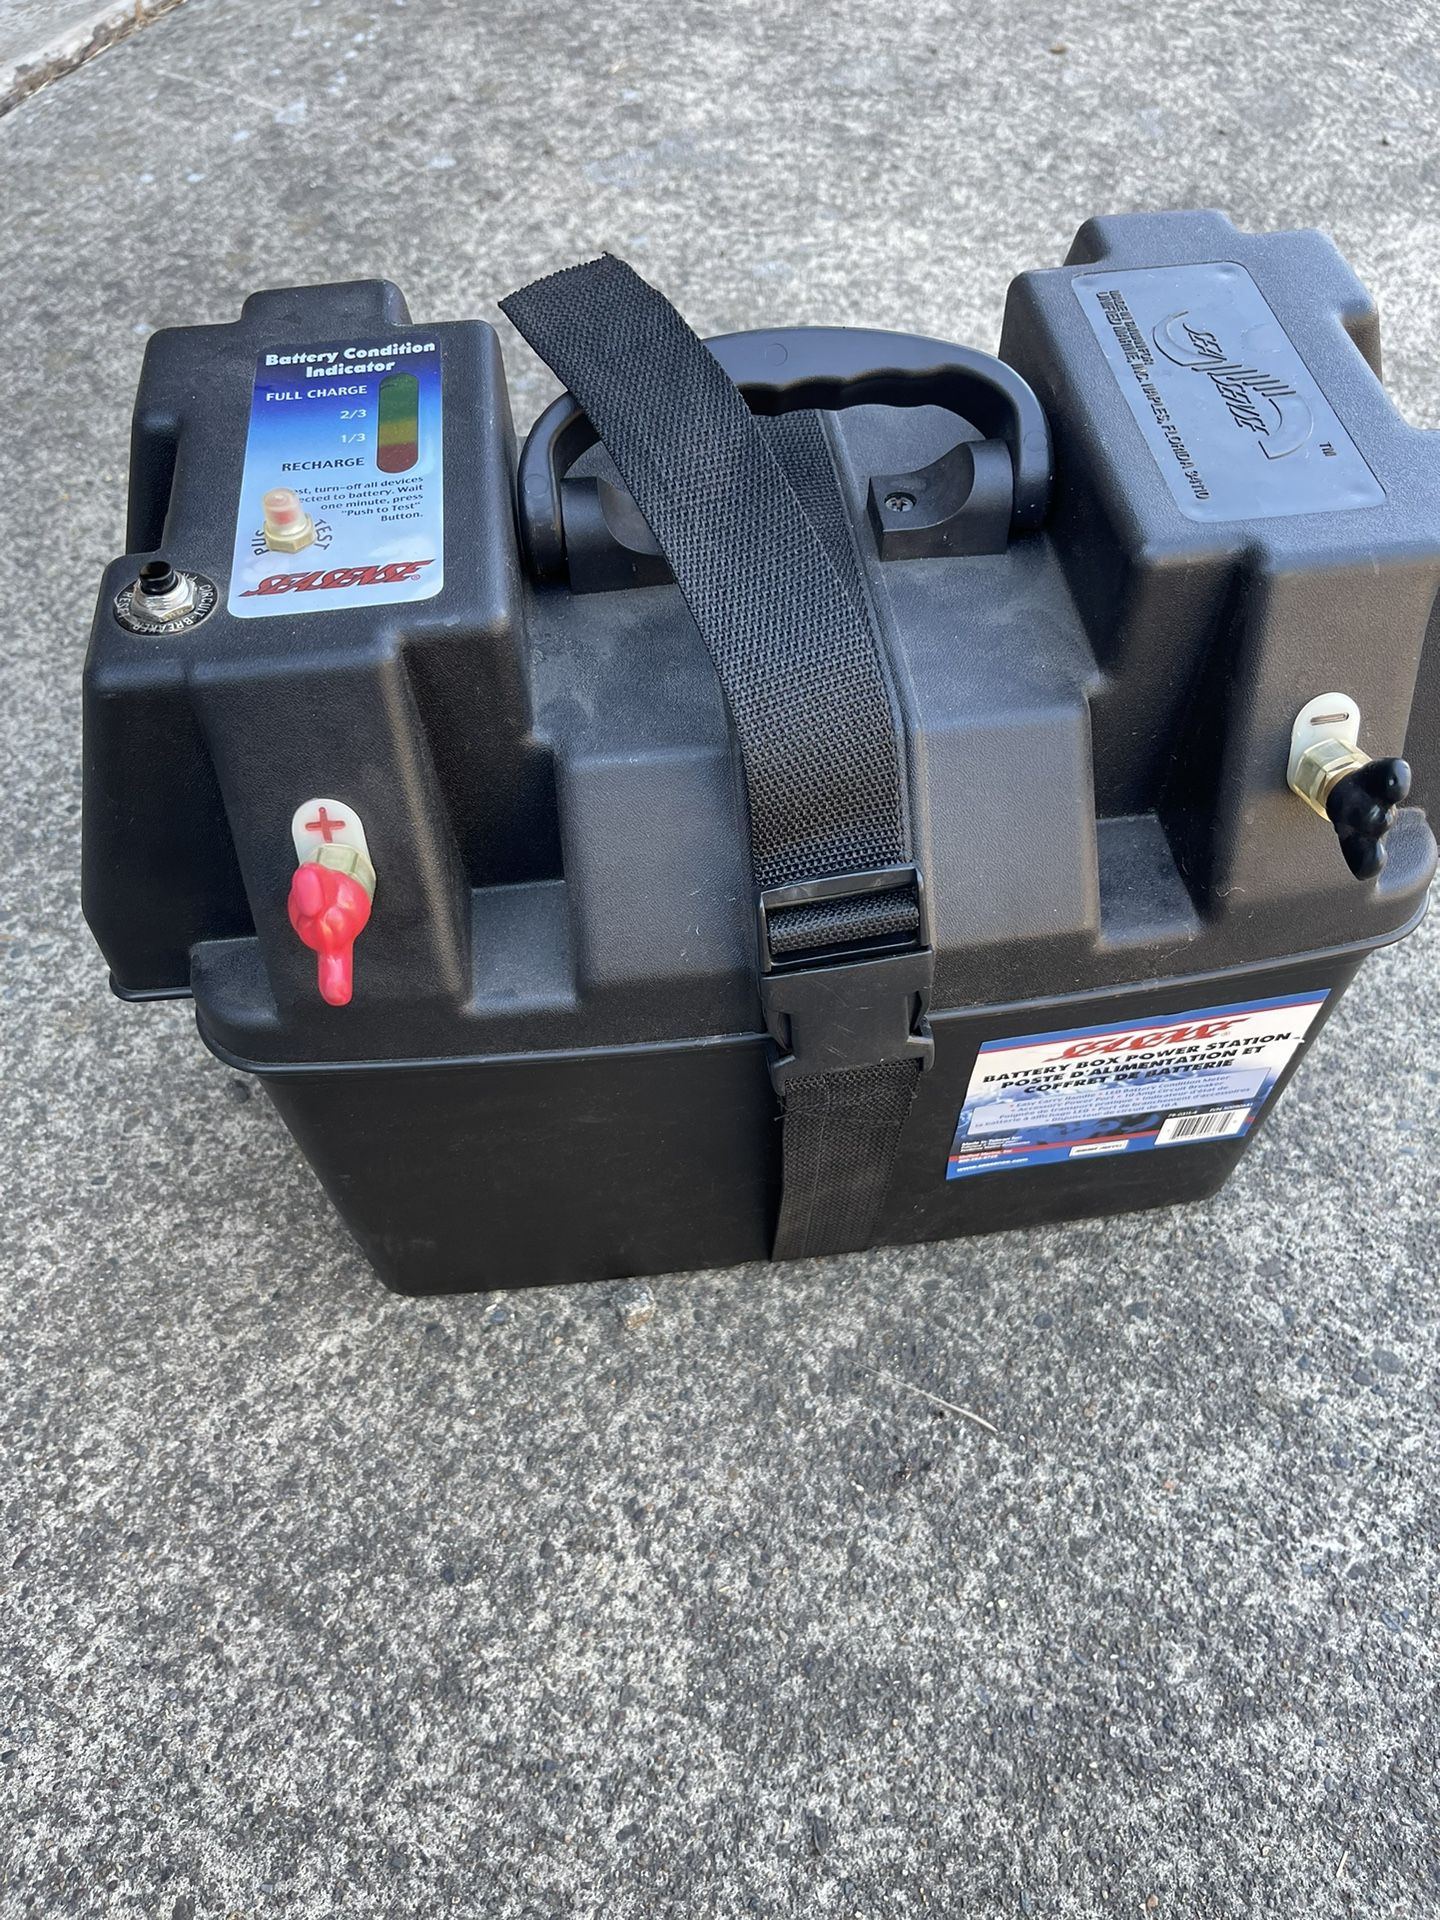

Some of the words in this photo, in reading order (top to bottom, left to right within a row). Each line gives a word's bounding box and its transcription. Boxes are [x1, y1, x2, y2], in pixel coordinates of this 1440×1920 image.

[265, 351, 339, 366] Battery
[343, 342, 436, 359] Condition
[306, 360, 395, 378] Indicator
[1095, 291, 1122, 325] UNIFIED
[1112, 326, 1140, 363] MARINE,
[1130, 363, 1149, 383] INC.
[1140, 383, 1170, 424] NAPLES,
[1161, 425, 1193, 469] FLORIDA
[266, 391, 303, 401] FULL
[307, 385, 368, 399] CHARGE
[340, 409, 367, 420] 2/3
[341, 433, 366, 443] 1/3
[281, 457, 365, 472] RECHARGE
[314, 482, 362, 493] turn-off
[364, 481, 378, 489] all
[380, 477, 423, 487] devices
[348, 489, 394, 499] battery.
[397, 485, 424, 493] Wait
[346, 498, 390, 508] minute,
[392, 494, 424, 504] press
[380, 511, 424, 521] Button.
[251, 530, 270, 556] PUS
[314, 518, 333, 551] TEST
[118, 591, 133, 618] RESET
[982, 1063, 1072, 1083] BATTERY
[1075, 1055, 1121, 1069] BOX
[1125, 1045, 1201, 1062] POWER
[1205, 1032, 1292, 1051] STATION
[1000, 1073, 1064, 1088] POSTE
[1070, 1050, 1237, 1079] D'ALIMENTATION
[1241, 1045, 1266, 1056] ET
[1023, 1076, 1112, 1094] COFFRET
[1113, 1071, 1139, 1082] DE
[1144, 1058, 1236, 1078] BATTERIE
[1158, 1079, 1201, 1088] Condition
